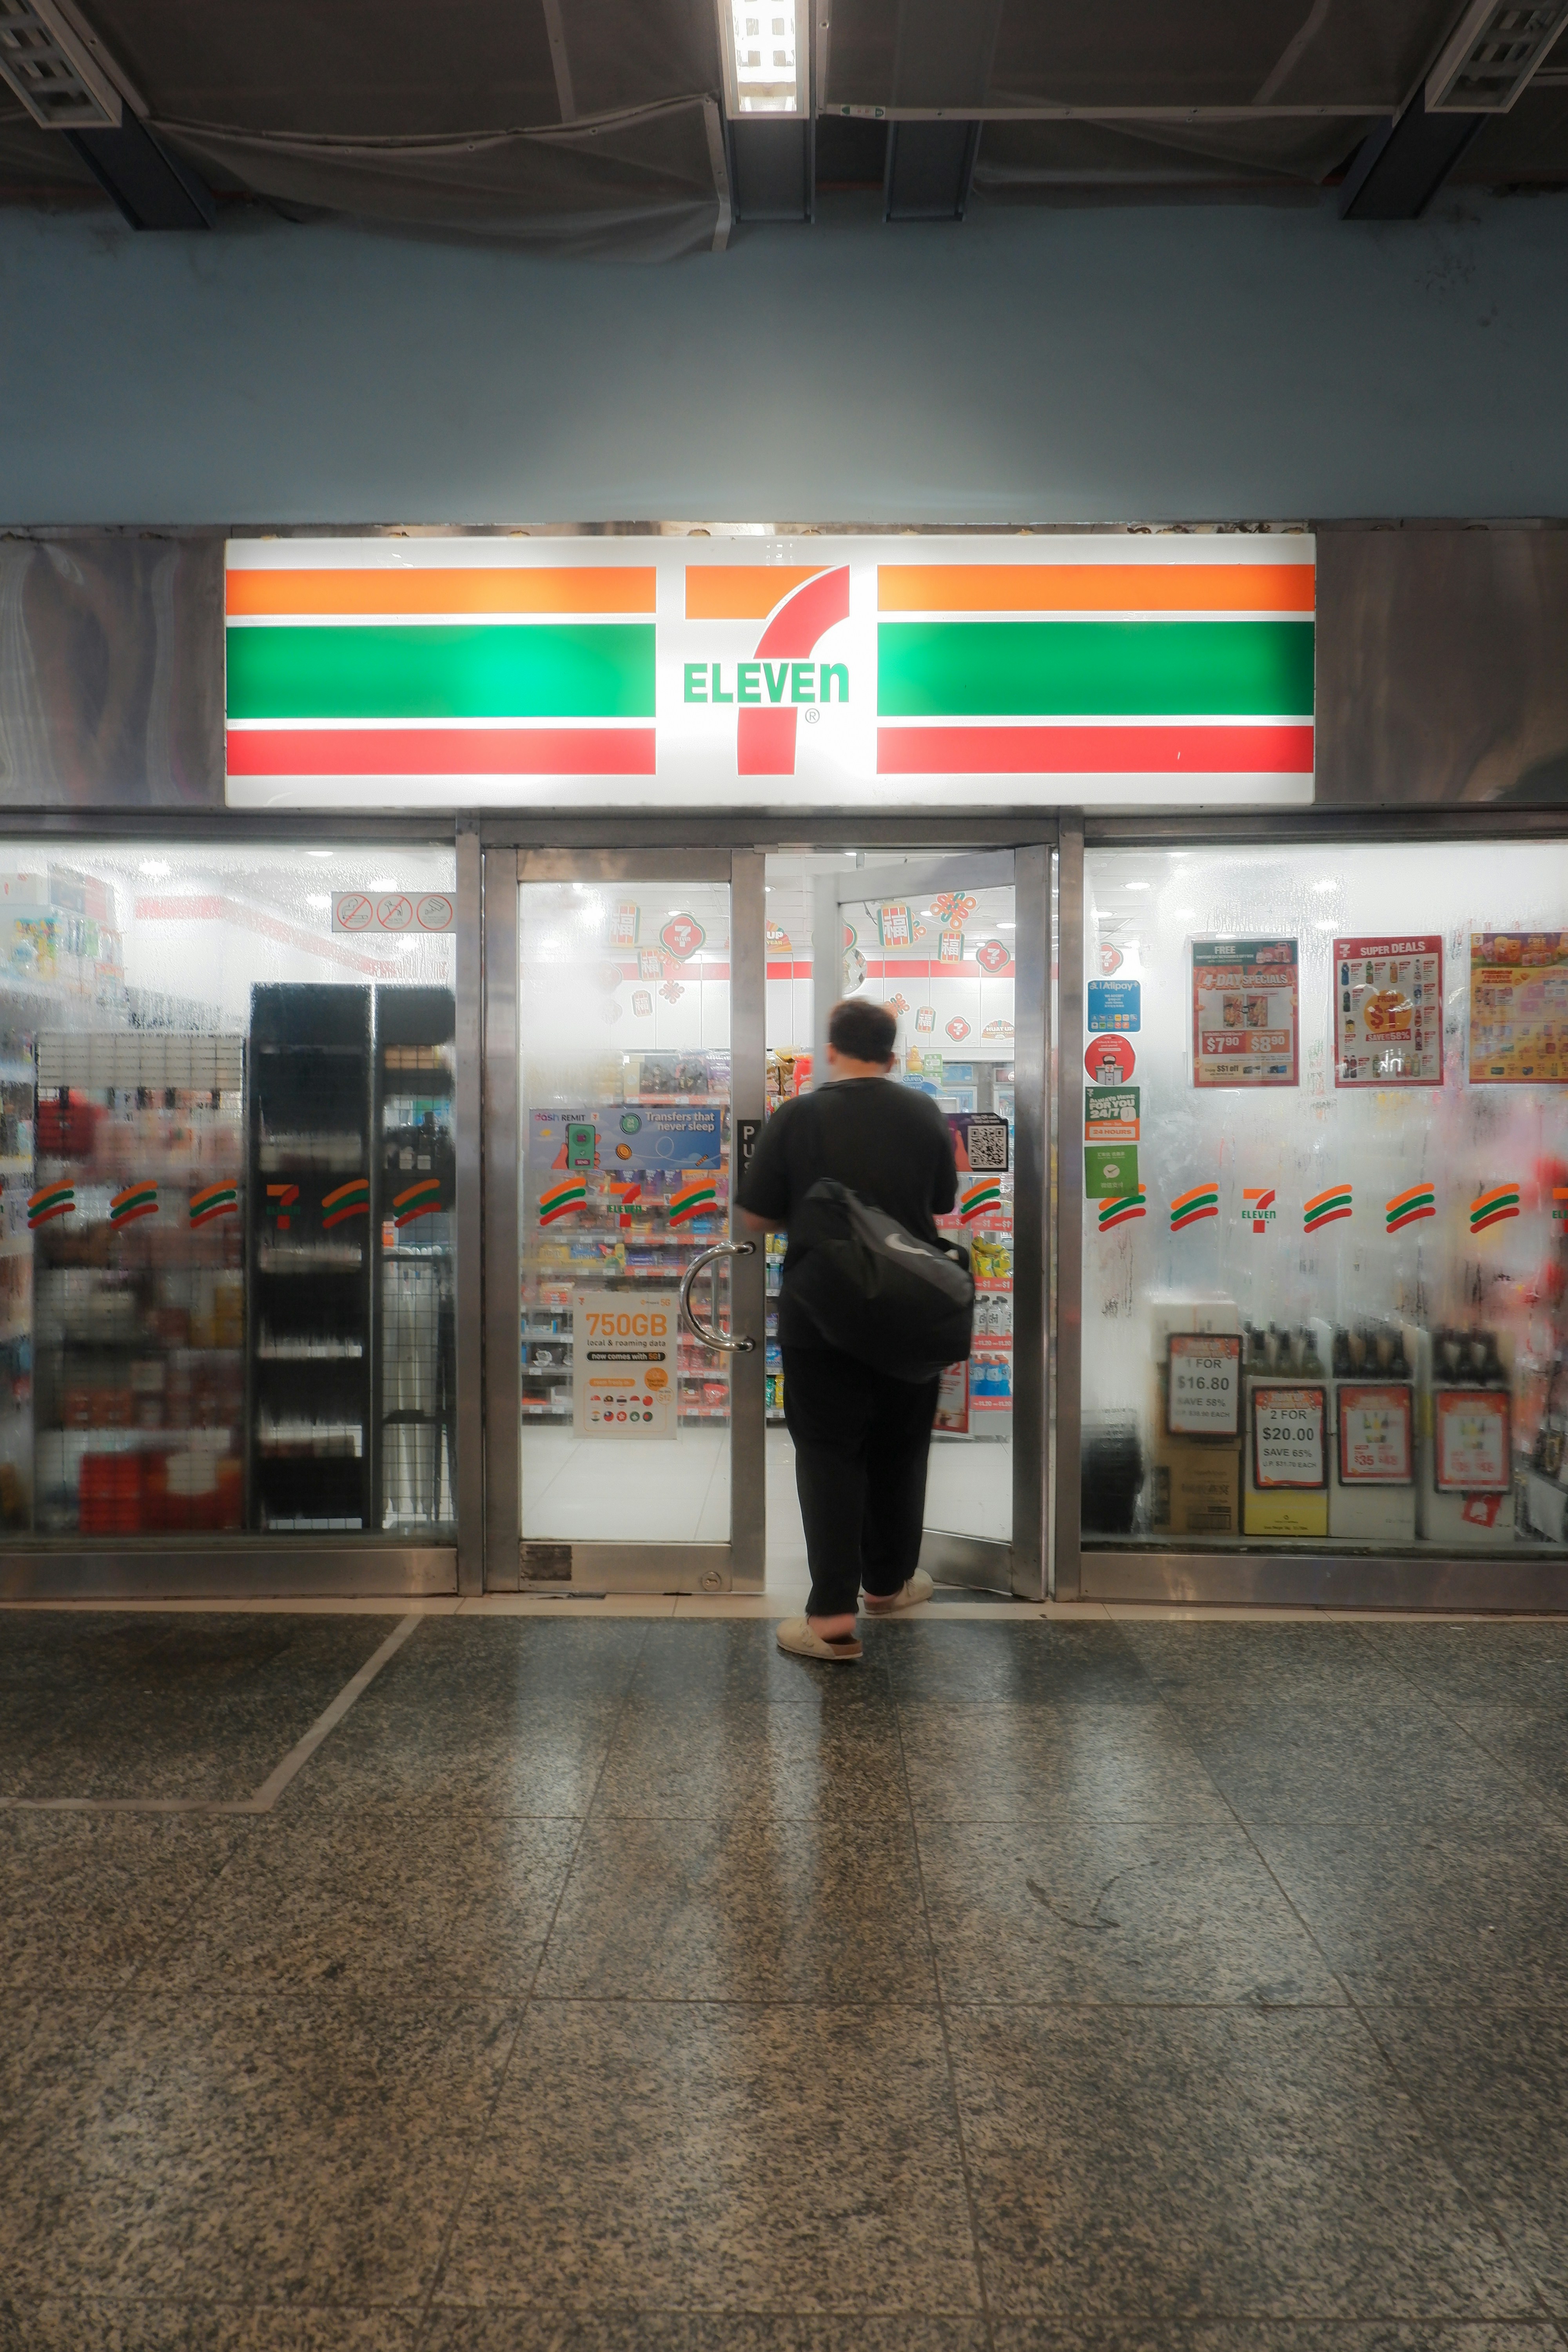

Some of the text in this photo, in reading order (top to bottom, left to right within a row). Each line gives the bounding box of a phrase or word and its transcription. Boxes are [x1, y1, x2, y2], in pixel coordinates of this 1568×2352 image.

[685, 564, 850, 775] 7
[884, 915, 907, 938] 福
[767, 931, 784, 939] UP
[942, 938, 961, 956] 福
[1215, 946, 1236, 954] FREE
[1360, 941, 1426, 956] SUPER DEALS
[1203, 973, 1288, 987] 4-DAY SPECIALS
[1377, 995, 1399, 1003] FROM
[1390, 1031, 1410, 1040] 58%
[1089, 1099, 1135, 1110] FOR YOU
[534, 1112, 560, 1122] dash
[645, 1112, 715, 1122] Transfers that
[1090, 1108, 1120, 1119] 24/7
[657, 1122, 715, 1133] never sleep
[1002, 1220, 1012, 1228] $1
[982, 1280, 991, 1288] $1
[1002, 1281, 1010, 1289] $1
[586, 1313, 668, 1336] 750GB
[615, 1339, 647, 1348] roaming
[1196, 1359, 1222, 1368] FOR
[1178, 1375, 1229, 1390] $16.80
[1206, 1398, 1226, 1407] 58%
[1270, 1410, 1307, 1420] 2 FOR
[1263, 1426, 1314, 1441] $20.00
[1263, 1448, 1290, 1456] SAVE
